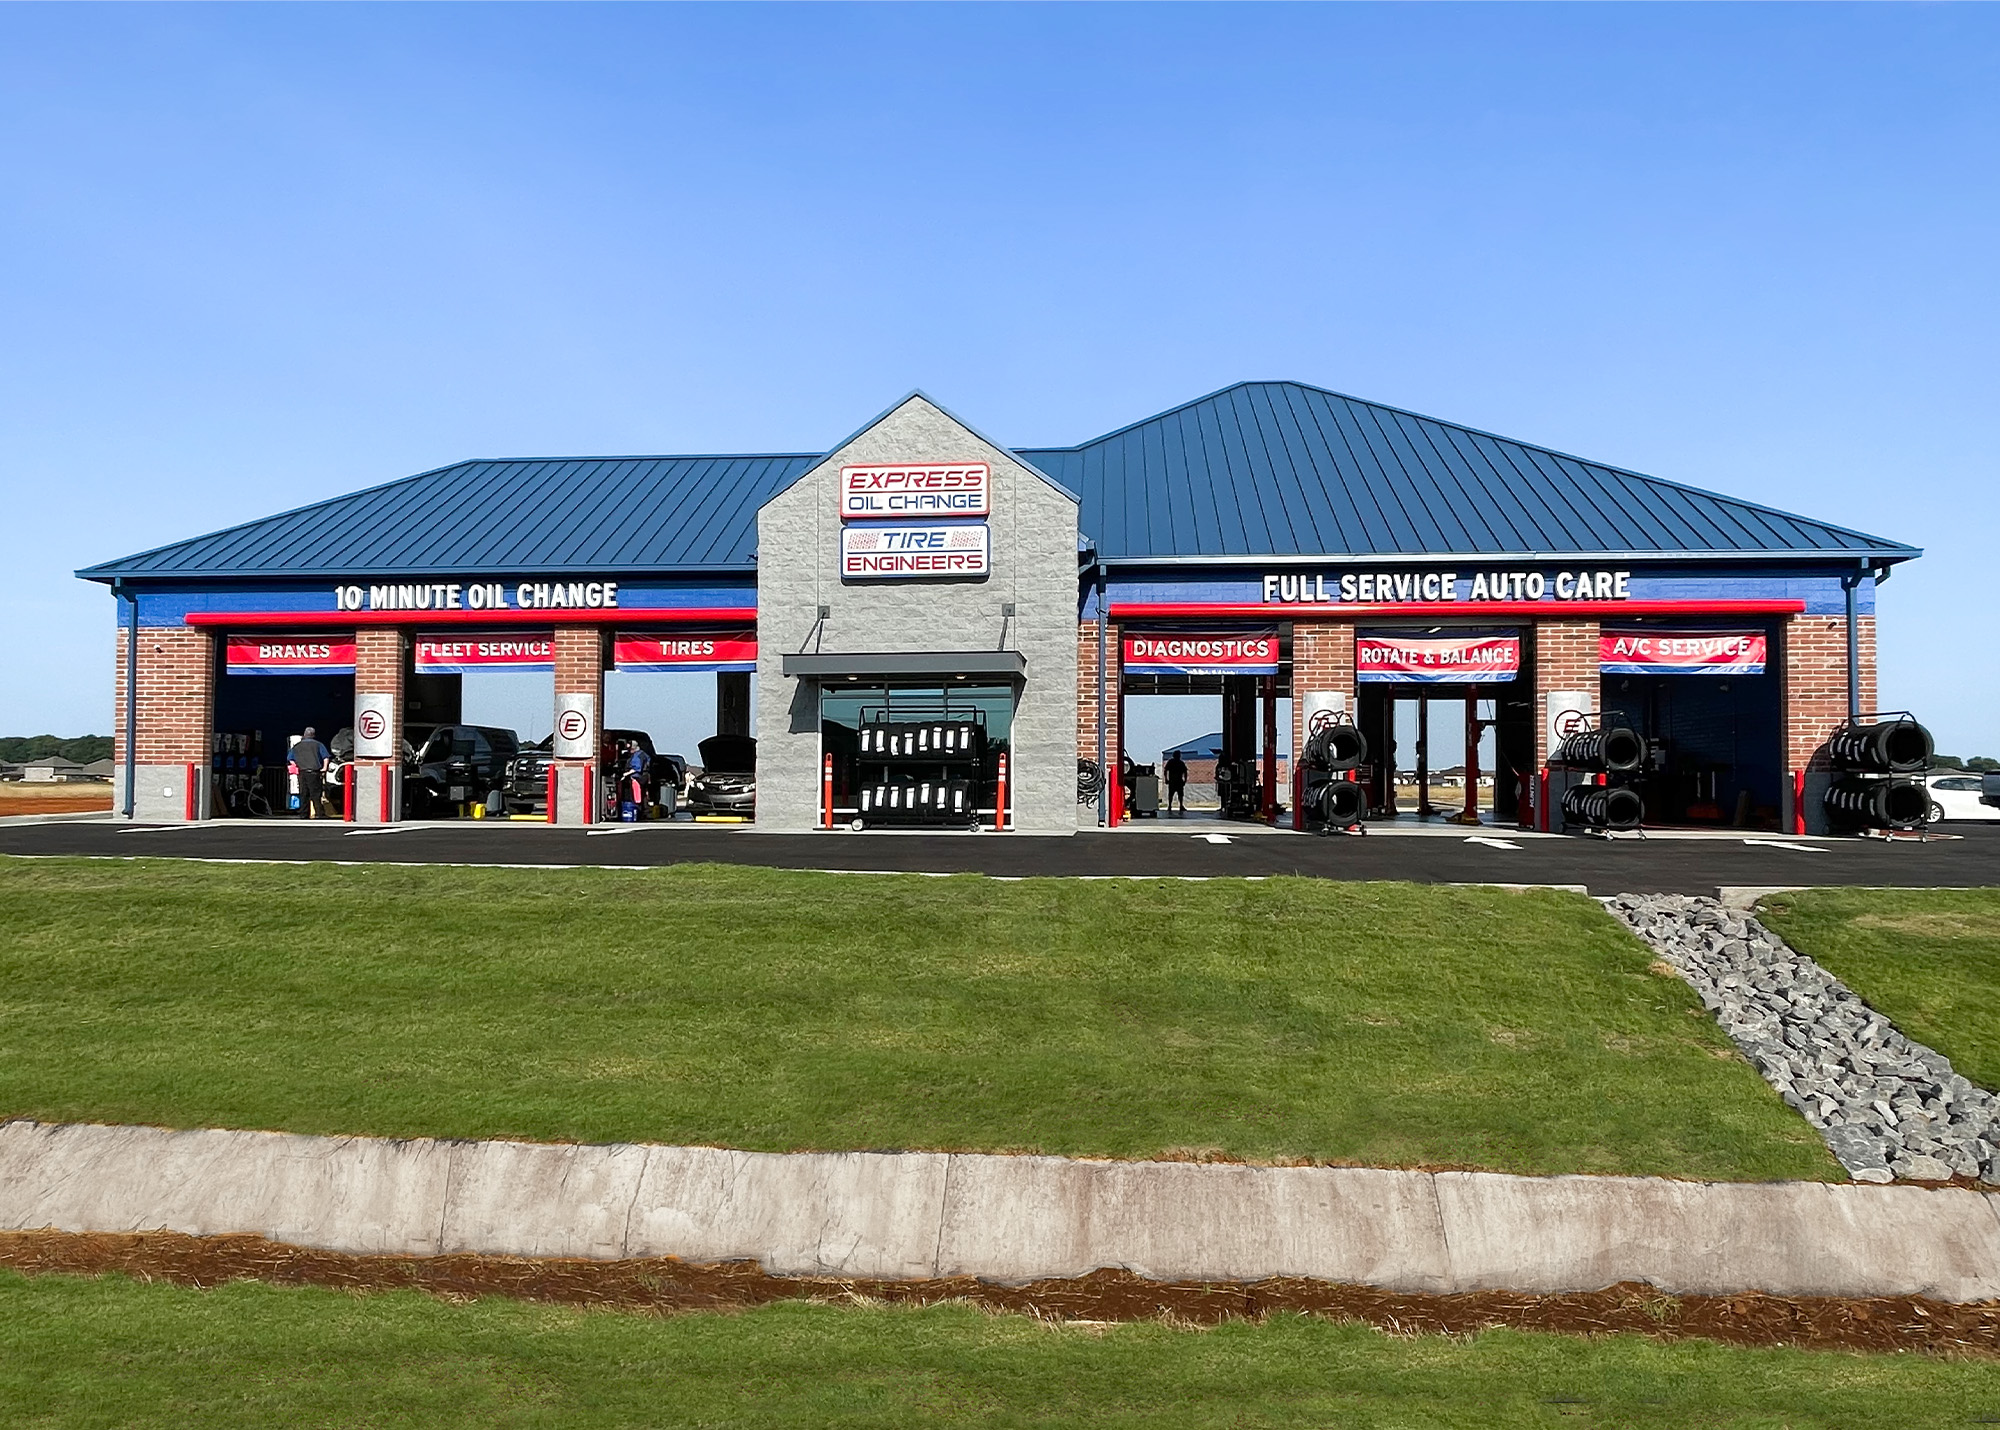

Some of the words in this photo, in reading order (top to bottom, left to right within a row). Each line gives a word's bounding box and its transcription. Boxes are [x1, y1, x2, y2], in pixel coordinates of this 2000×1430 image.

[849, 470, 984, 489] EXPRESS
[849, 496, 883, 510] OIL
[889, 494, 982, 509] CHANGE
[883, 531, 947, 549] TIRE
[847, 555, 983, 572] ENGINEERS
[1263, 574, 1331, 601] FULL
[1340, 573, 1457, 601] SERVICE
[1471, 572, 1545, 600] AUTO
[1556, 571, 1631, 599] CARE
[335, 585, 361, 610] 10
[370, 584, 462, 610] MINUTE
[468, 583, 508, 609] OIL
[517, 582, 617, 608] CHANGE
[259, 644, 331, 659] BRAKES
[420, 642, 473, 658] FLEET
[478, 641, 551, 657] SERVICE
[660, 640, 715, 656] TIRES
[1133, 640, 1270, 658] DIAGNOSTICS
[1613, 637, 1651, 656] A/C
[1659, 638, 1751, 656] SERVICE
[1361, 647, 1419, 665] ROTATE
[1424, 648, 1435, 665] &
[1440, 647, 1514, 664] BALANCE
